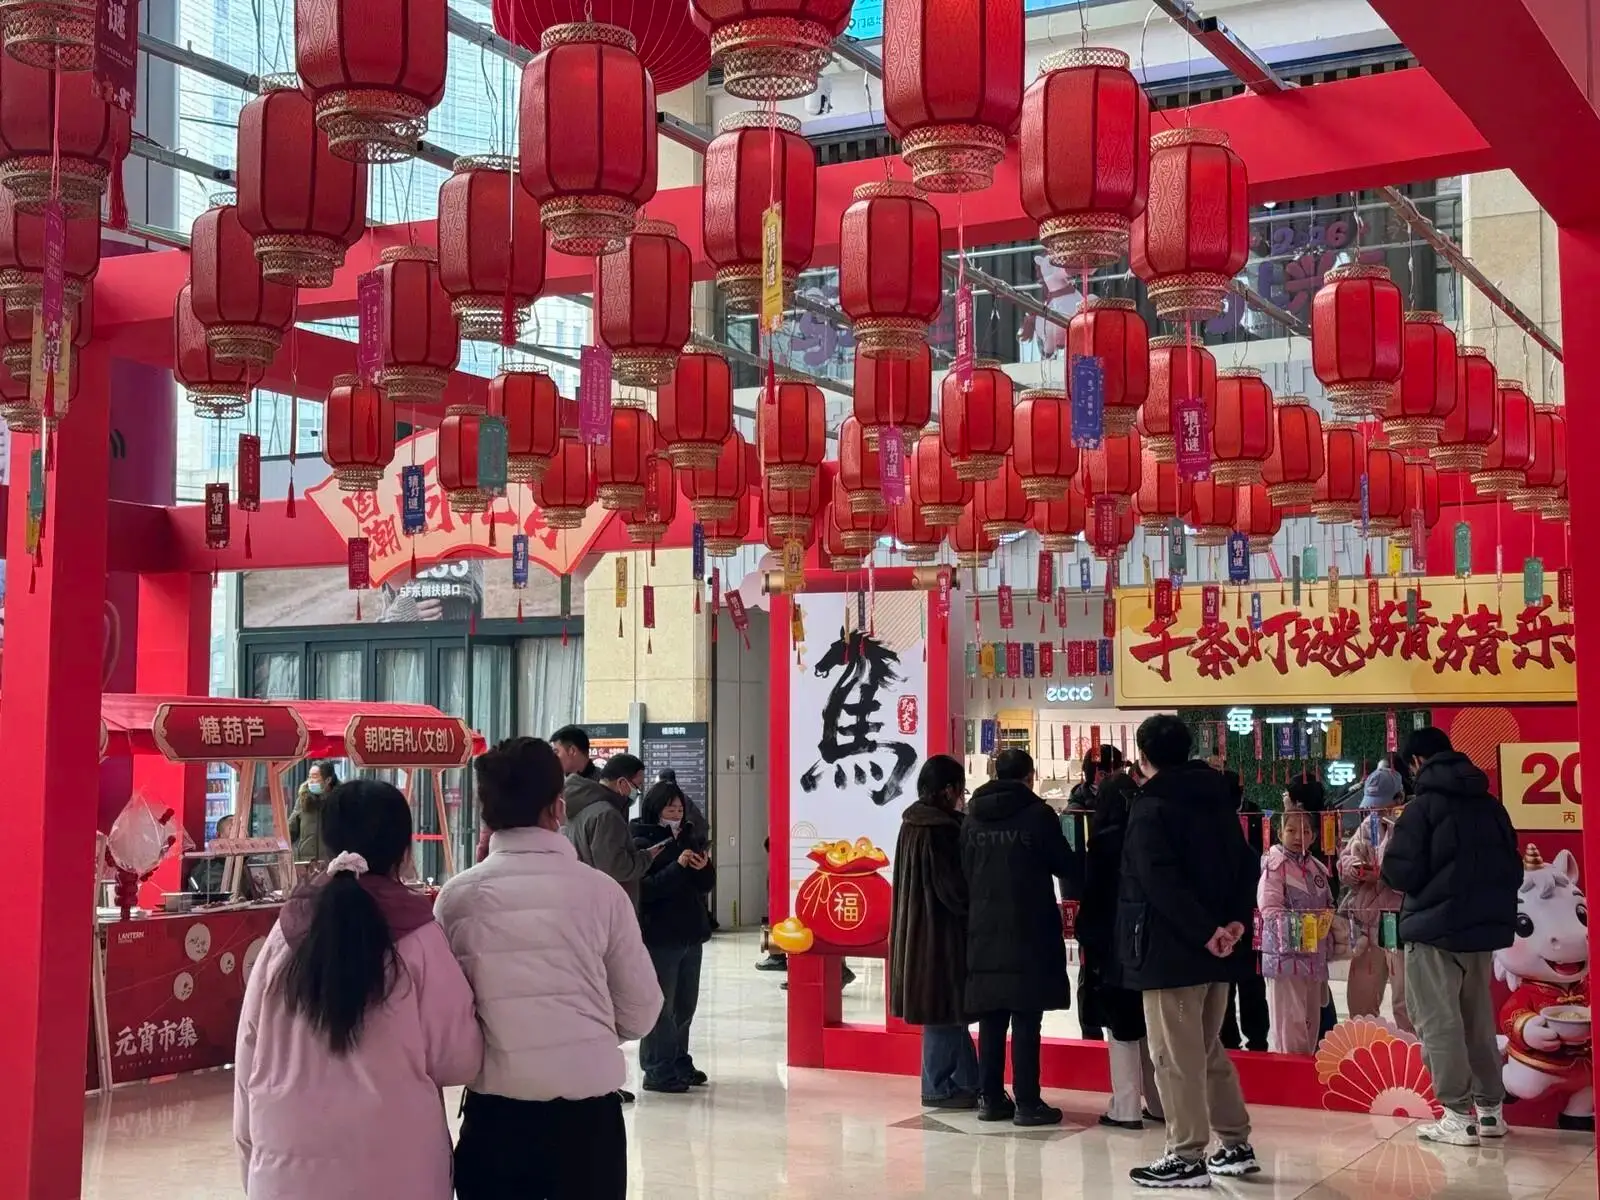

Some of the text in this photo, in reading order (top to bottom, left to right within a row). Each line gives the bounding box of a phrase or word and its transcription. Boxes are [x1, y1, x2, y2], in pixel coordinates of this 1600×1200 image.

[107, 0, 126, 40] 谜
[767, 224, 777, 286] 猜灯谜
[958, 301, 968, 355] 猜灯谜
[1183, 410, 1200, 452] 猜灯谜
[887, 439, 898, 477] 猜灯谜
[408, 475, 419, 509] 猜灯谜
[211, 492, 224, 525] 猜灯谜
[342, 488, 402, 562] 国潮
[1172, 526, 1182, 555] 猜灯谜
[515, 542, 525, 570] 猜灯谜
[1232, 540, 1244, 566] 猜灯谜
[400, 585, 461, 598] 5F东侧扶梯口
[1129, 595, 1576, 682] 千条灯谜猜猜乐
[1046, 686, 1093, 701] ecco
[199, 715, 265, 745] 糖葫芦
[1227, 707, 1334, 736] 每一天
[364, 726, 455, 753] 朝阳有礼(文创)
[1327, 761, 1357, 786] 每
[1561, 811, 1576, 823] 丙
[834, 891, 859, 922] 福
[114, 1016, 199, 1057] 元宵市集
